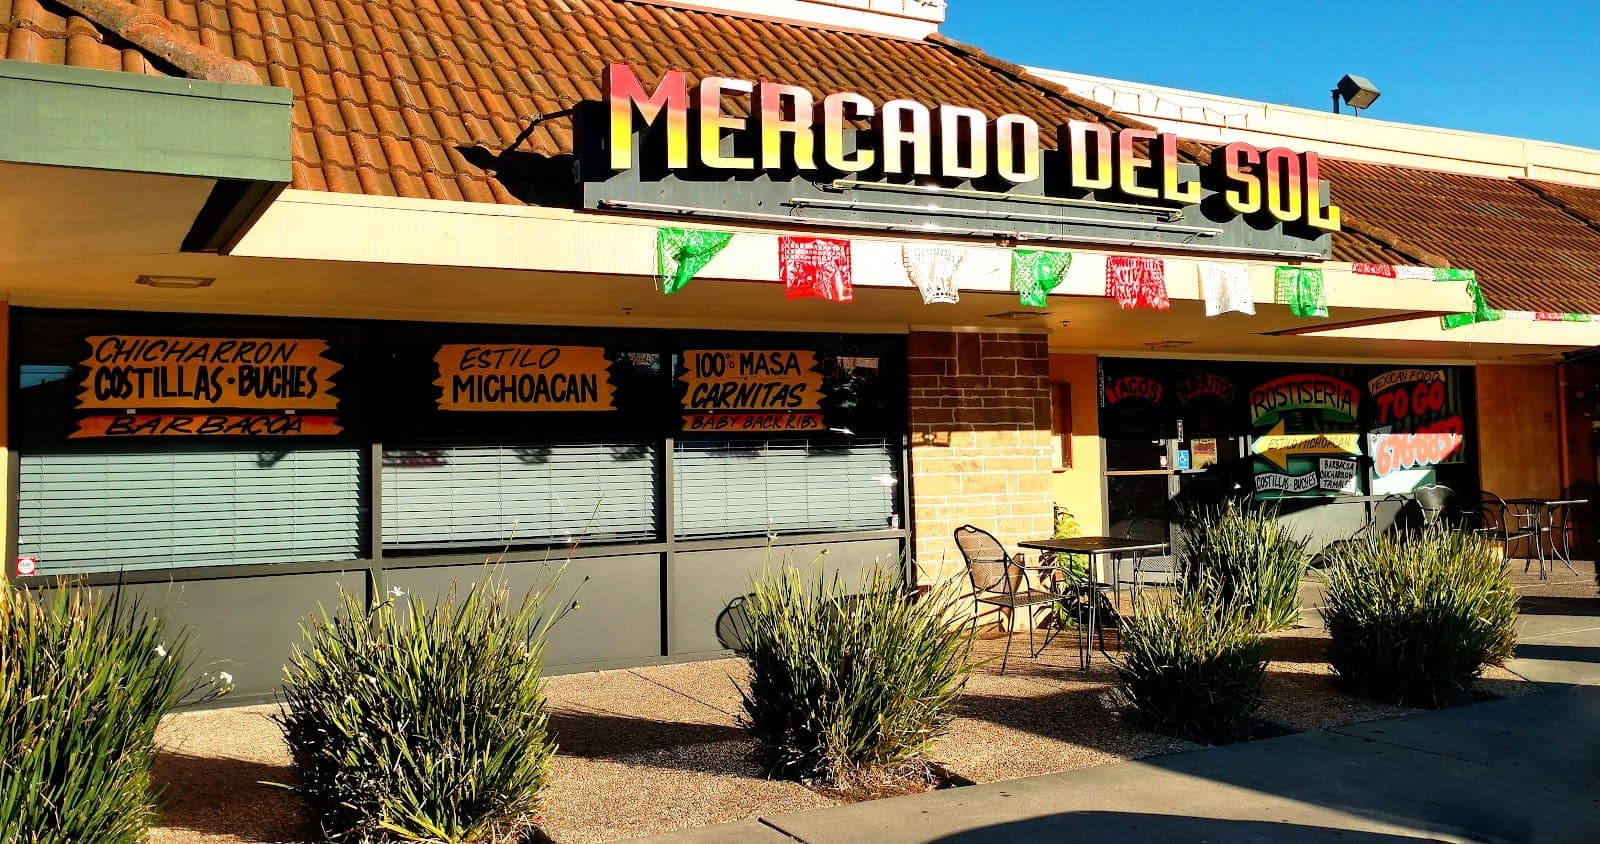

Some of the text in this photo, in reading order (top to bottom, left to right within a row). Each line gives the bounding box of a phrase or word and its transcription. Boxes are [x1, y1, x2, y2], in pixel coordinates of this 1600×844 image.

[609, 63, 1342, 233] MERCADO DEL SOL
[95, 336, 299, 364] CHICHARRON
[460, 347, 561, 370] ESTILO
[696, 351, 801, 379] 100% MASA
[94, 364, 318, 404] COSTILLAS BUCHES
[452, 373, 598, 404] MICHOACAN
[1108, 377, 1158, 400] TACOS
[1372, 369, 1440, 393] MEXICAN FOOD
[691, 382, 807, 409] CARNITAS
[1252, 384, 1352, 416] ROSTISERIA
[1377, 382, 1444, 422] TO GO
[104, 415, 303, 436] BARBACOA
[690, 414, 820, 430] BABY BACK RIBS
[1269, 436, 1351, 450] ESTILO MICHOACAN
[1325, 461, 1355, 470] BARBACOA
[1257, 474, 1316, 489] COSTILLAS BUCHES
